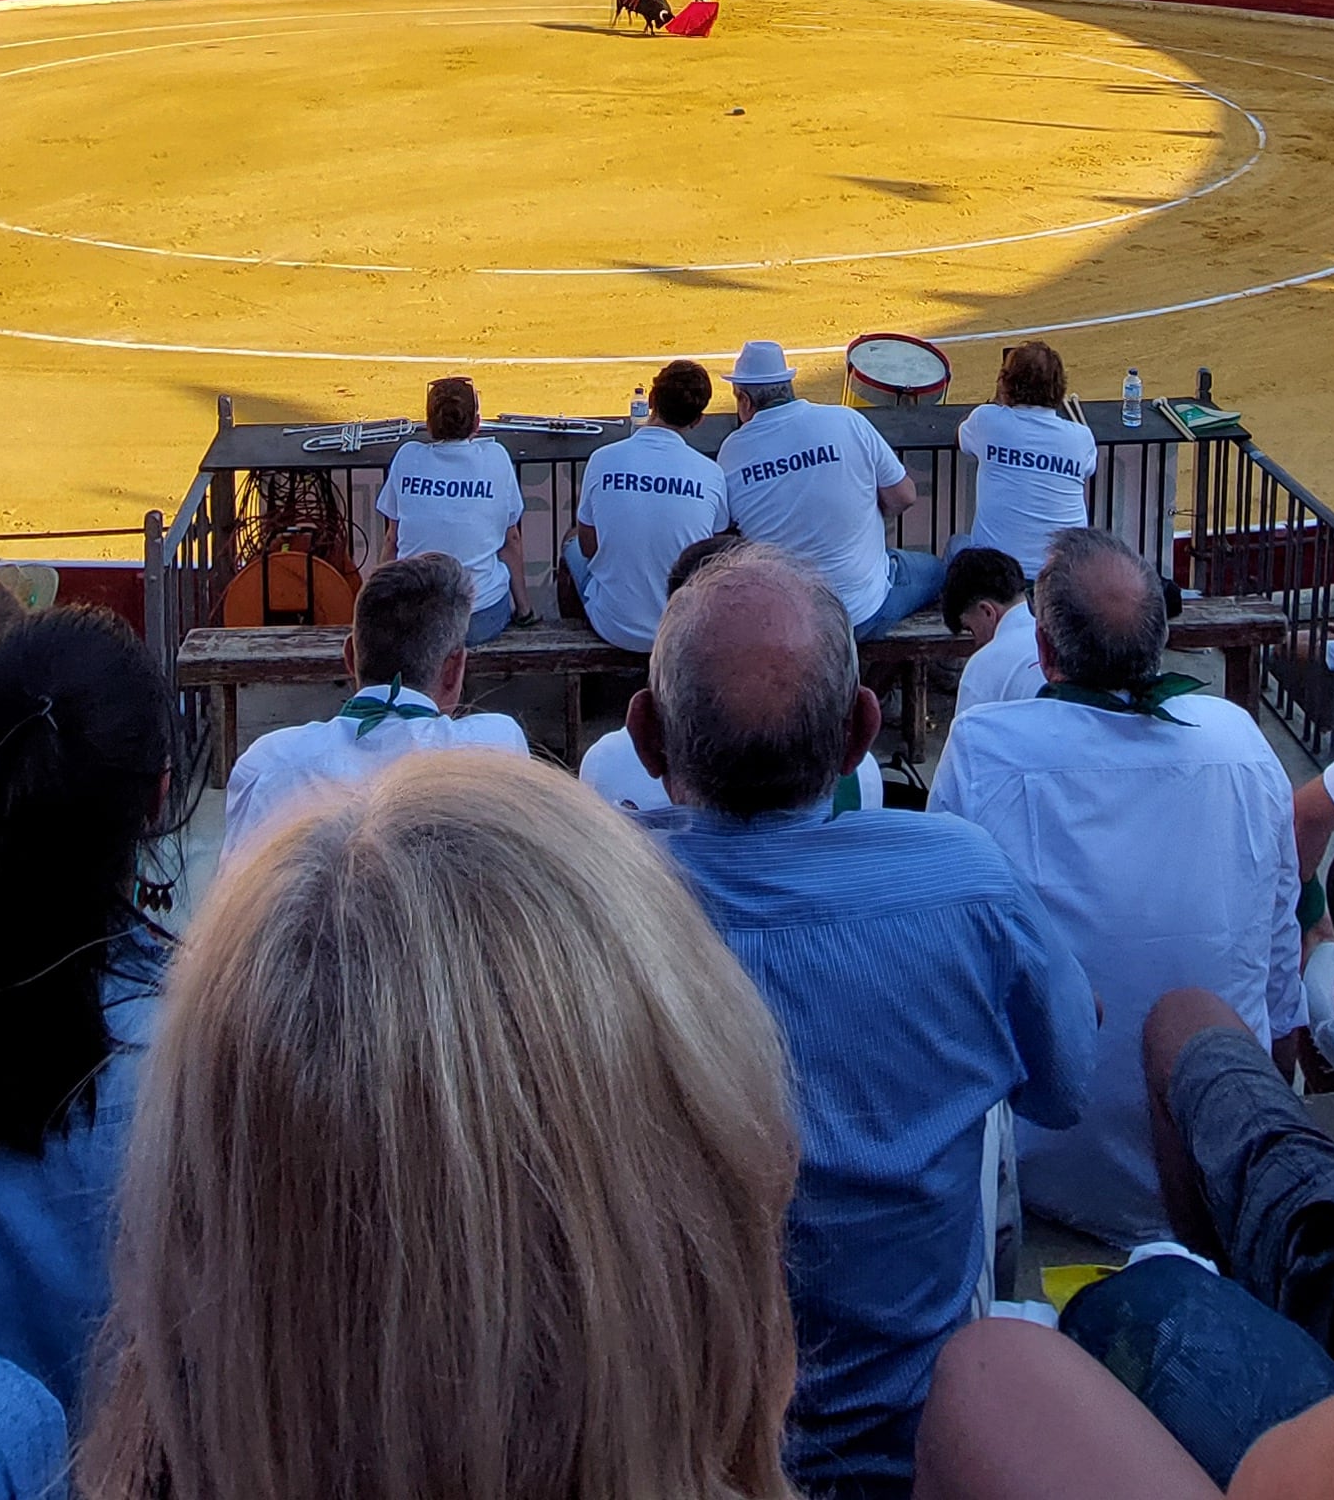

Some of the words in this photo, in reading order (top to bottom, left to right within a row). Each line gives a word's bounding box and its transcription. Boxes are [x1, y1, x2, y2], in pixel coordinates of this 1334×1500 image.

[741, 444, 840, 485] PERSONAL
[986, 444, 1082, 477] PERSONAL
[401, 476, 494, 499] PERSONAL
[602, 473, 705, 500] PERSONAL
